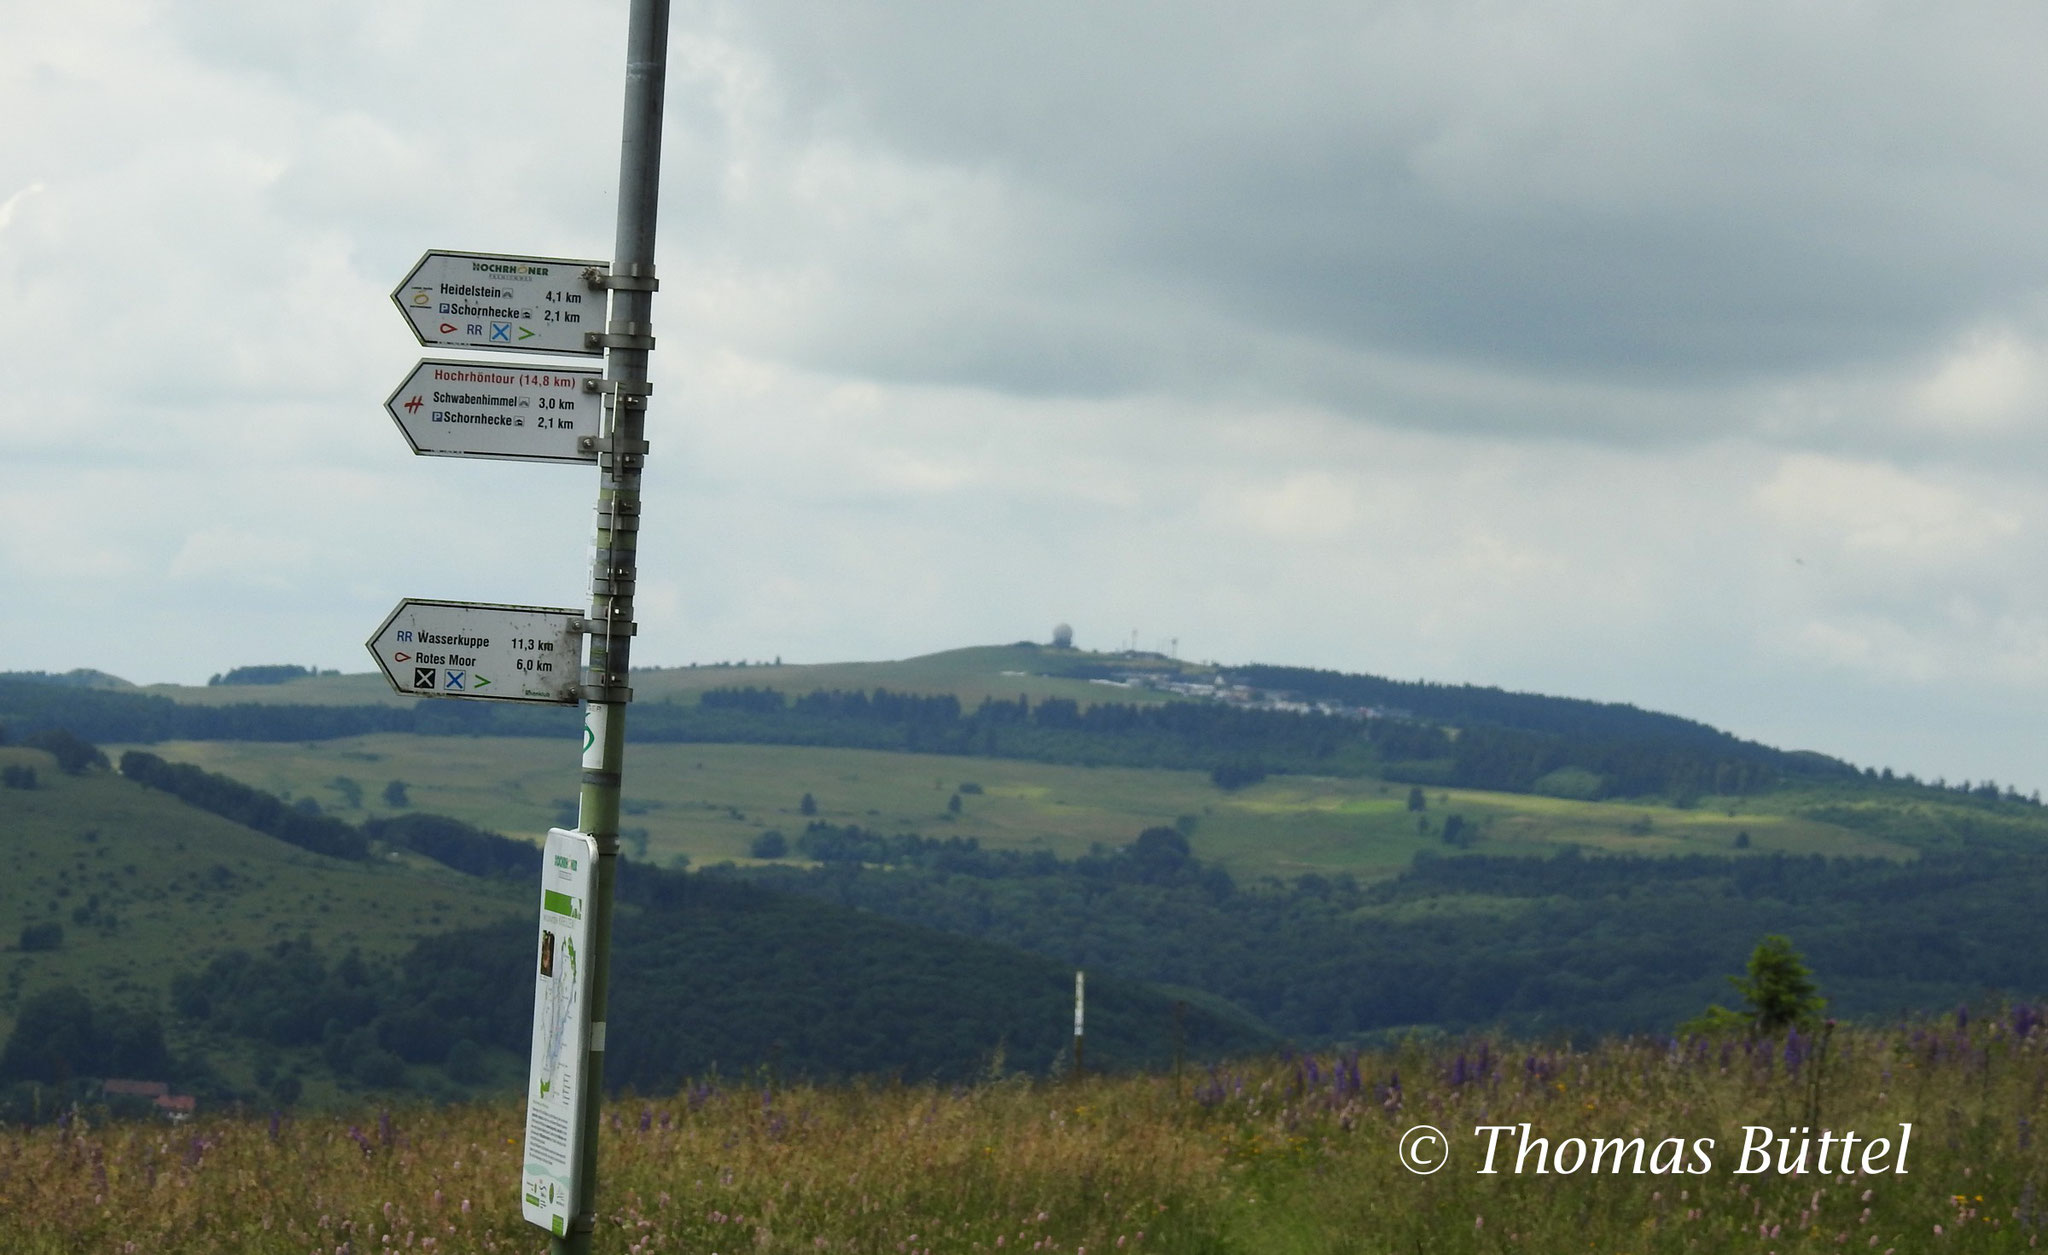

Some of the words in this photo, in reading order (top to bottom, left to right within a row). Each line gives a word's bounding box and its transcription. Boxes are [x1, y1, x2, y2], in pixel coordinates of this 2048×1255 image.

[440, 283, 501, 298] Heidelstein
[545, 291, 562, 303] 4,1
[565, 292, 581, 303] km
[451, 303, 520, 319] Schornhecke
[544, 310, 561, 323] 2,1
[565, 312, 580, 323] km
[467, 324, 483, 336] RR
[434, 369, 515, 385] Hochrhöntour
[519, 374, 550, 387] (14,8
[554, 376, 576, 389] km)
[433, 392, 517, 407] Schwabenhimmel
[538, 398, 556, 411] 3,0
[559, 399, 575, 410] km
[444, 411, 512, 426] Schornhecke
[537, 417, 554, 429] 2,1
[558, 418, 574, 429] km
[397, 631, 412, 642] RR
[418, 631, 490, 648] Wasserkuppe
[511, 638, 535, 651] 11,3
[538, 640, 554, 651] km
[416, 652, 446, 665] Rotes
[449, 653, 476, 667] Moor
[516, 658, 533, 672] 6,0
[537, 660, 553, 672] km
